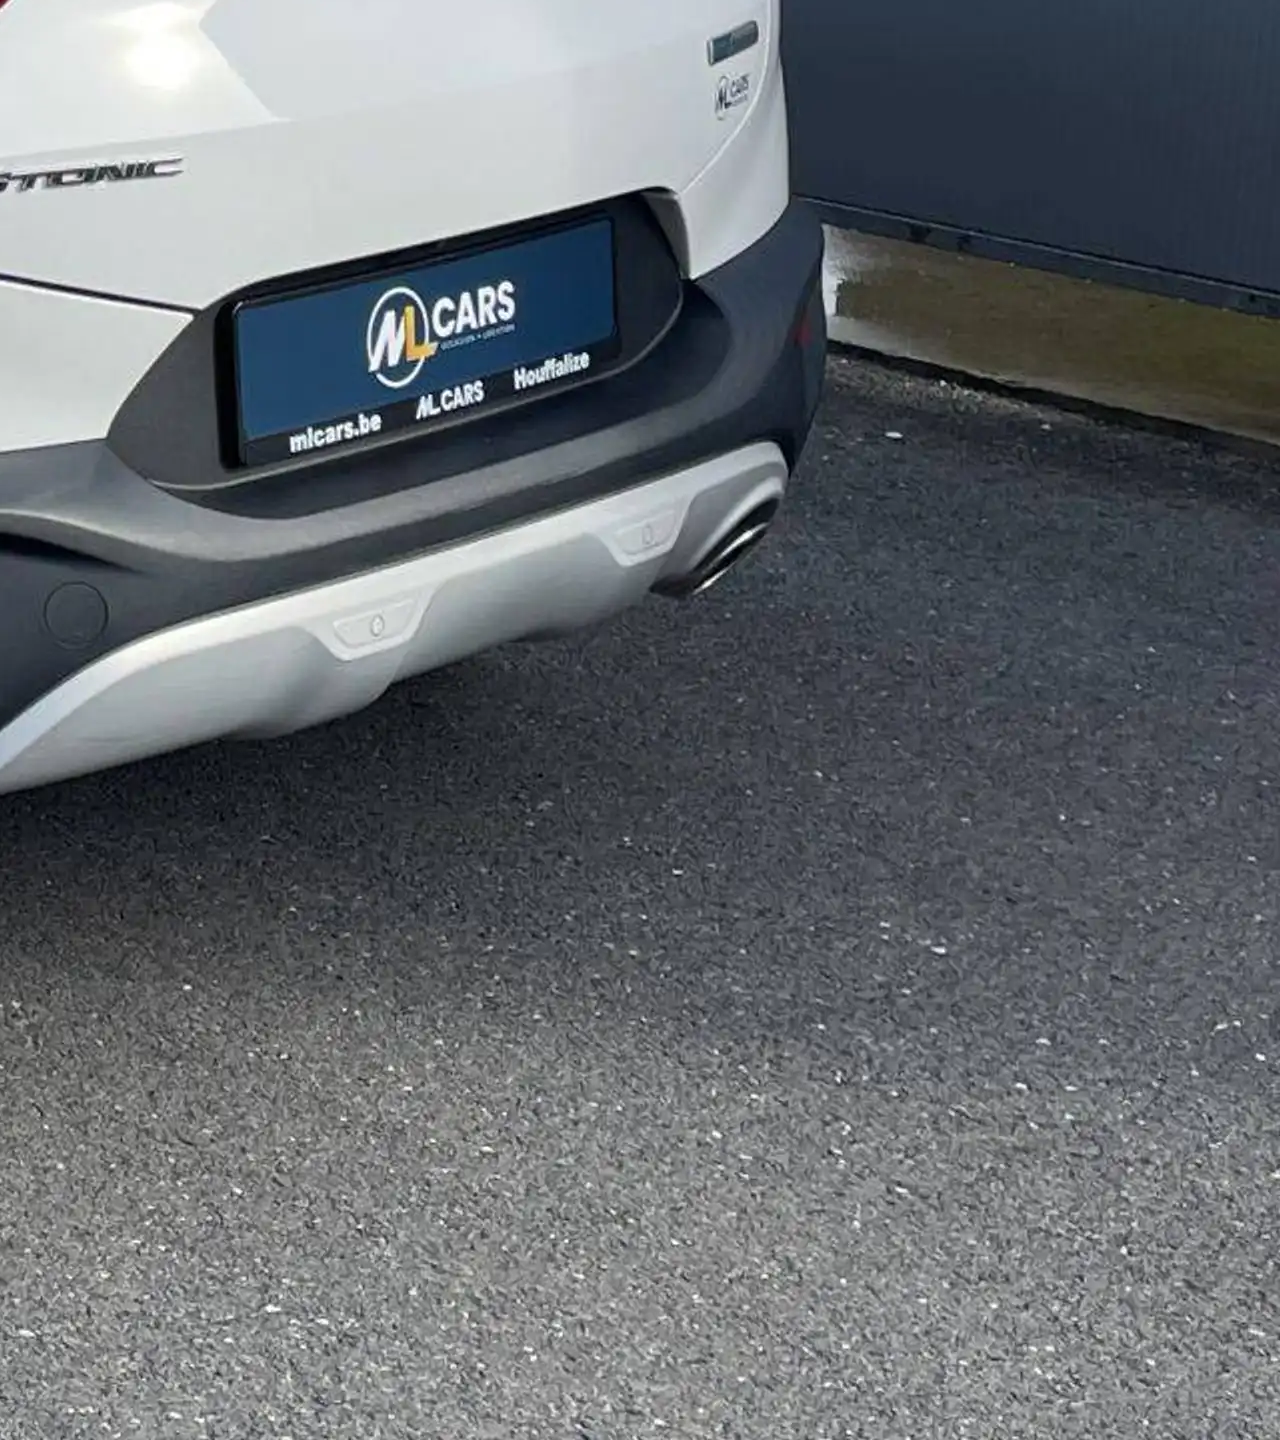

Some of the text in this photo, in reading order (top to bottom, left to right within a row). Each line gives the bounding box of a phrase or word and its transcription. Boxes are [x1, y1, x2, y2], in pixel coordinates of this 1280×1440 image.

[368, 305, 439, 372] ML
[432, 280, 516, 338] CARS
[289, 412, 382, 453] mlcars.be
[441, 380, 485, 412] CARS
[513, 351, 590, 390] Houffalize
